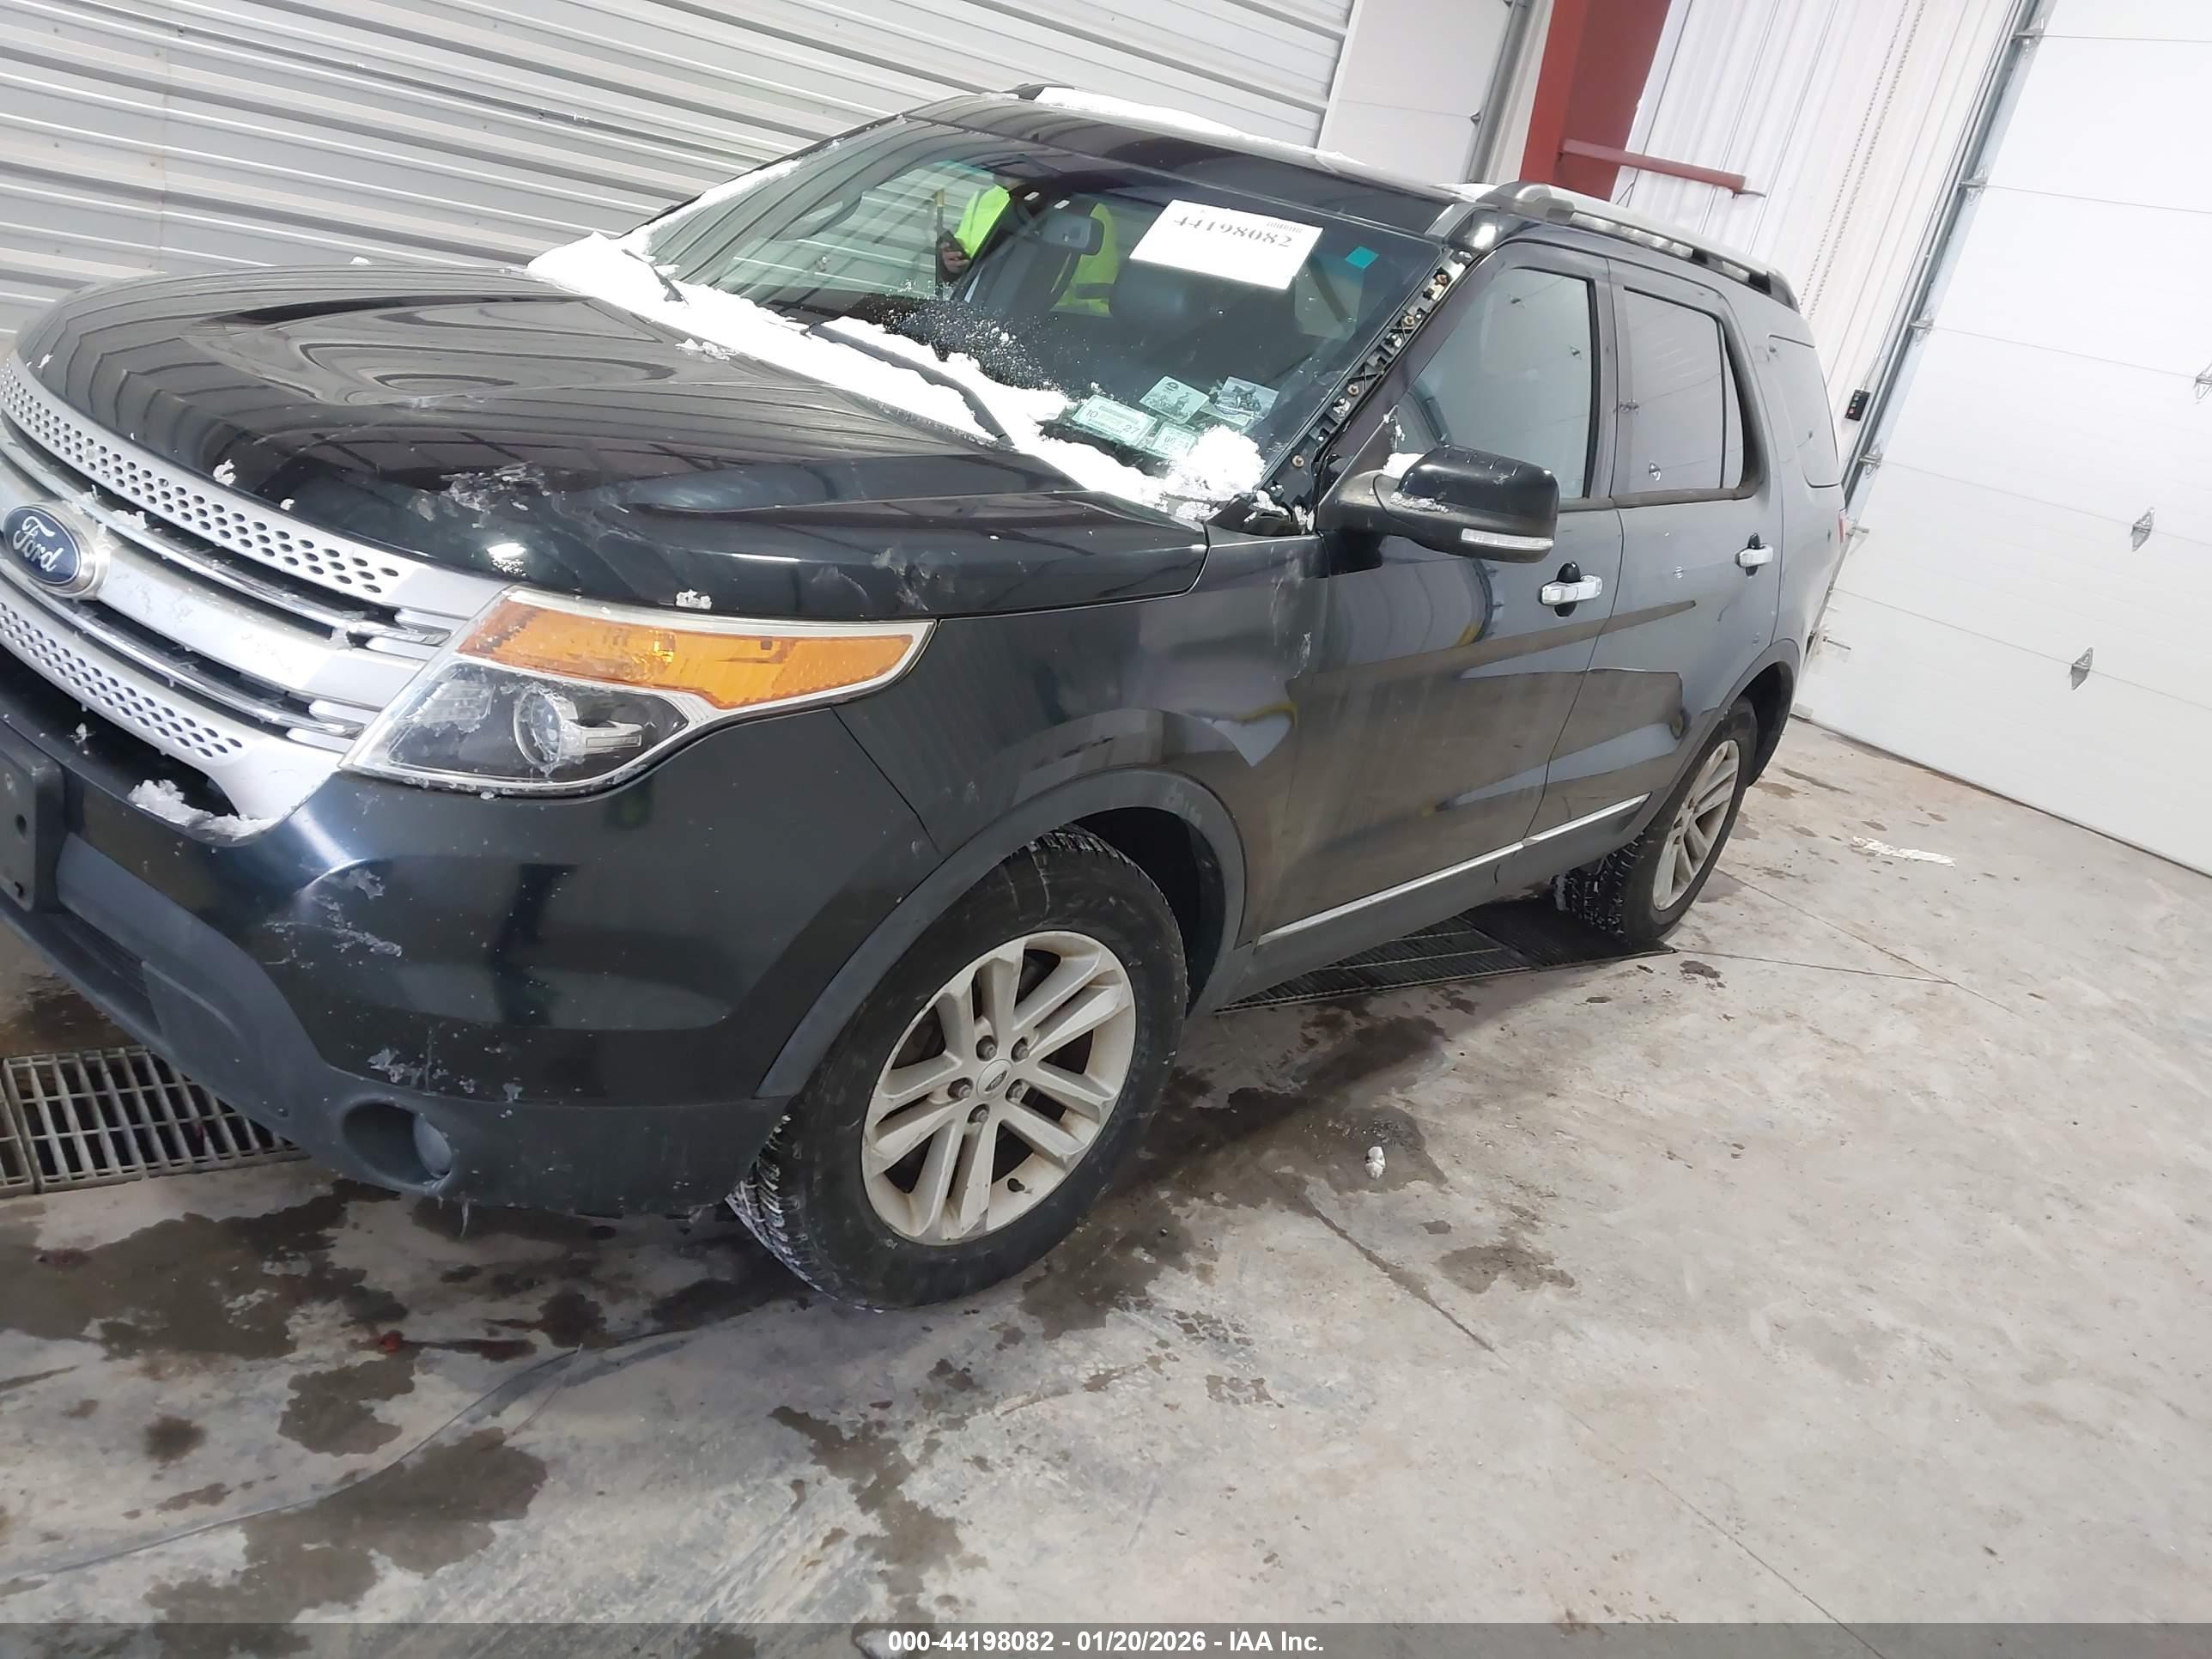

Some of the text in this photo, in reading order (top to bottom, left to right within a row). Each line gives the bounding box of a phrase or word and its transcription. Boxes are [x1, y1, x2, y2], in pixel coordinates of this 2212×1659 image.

[1174, 216, 1292, 247] 44198082
[1085, 409, 1099, 419] 10
[1121, 423, 1140, 435] 27
[12, 515, 64, 572] Ford
